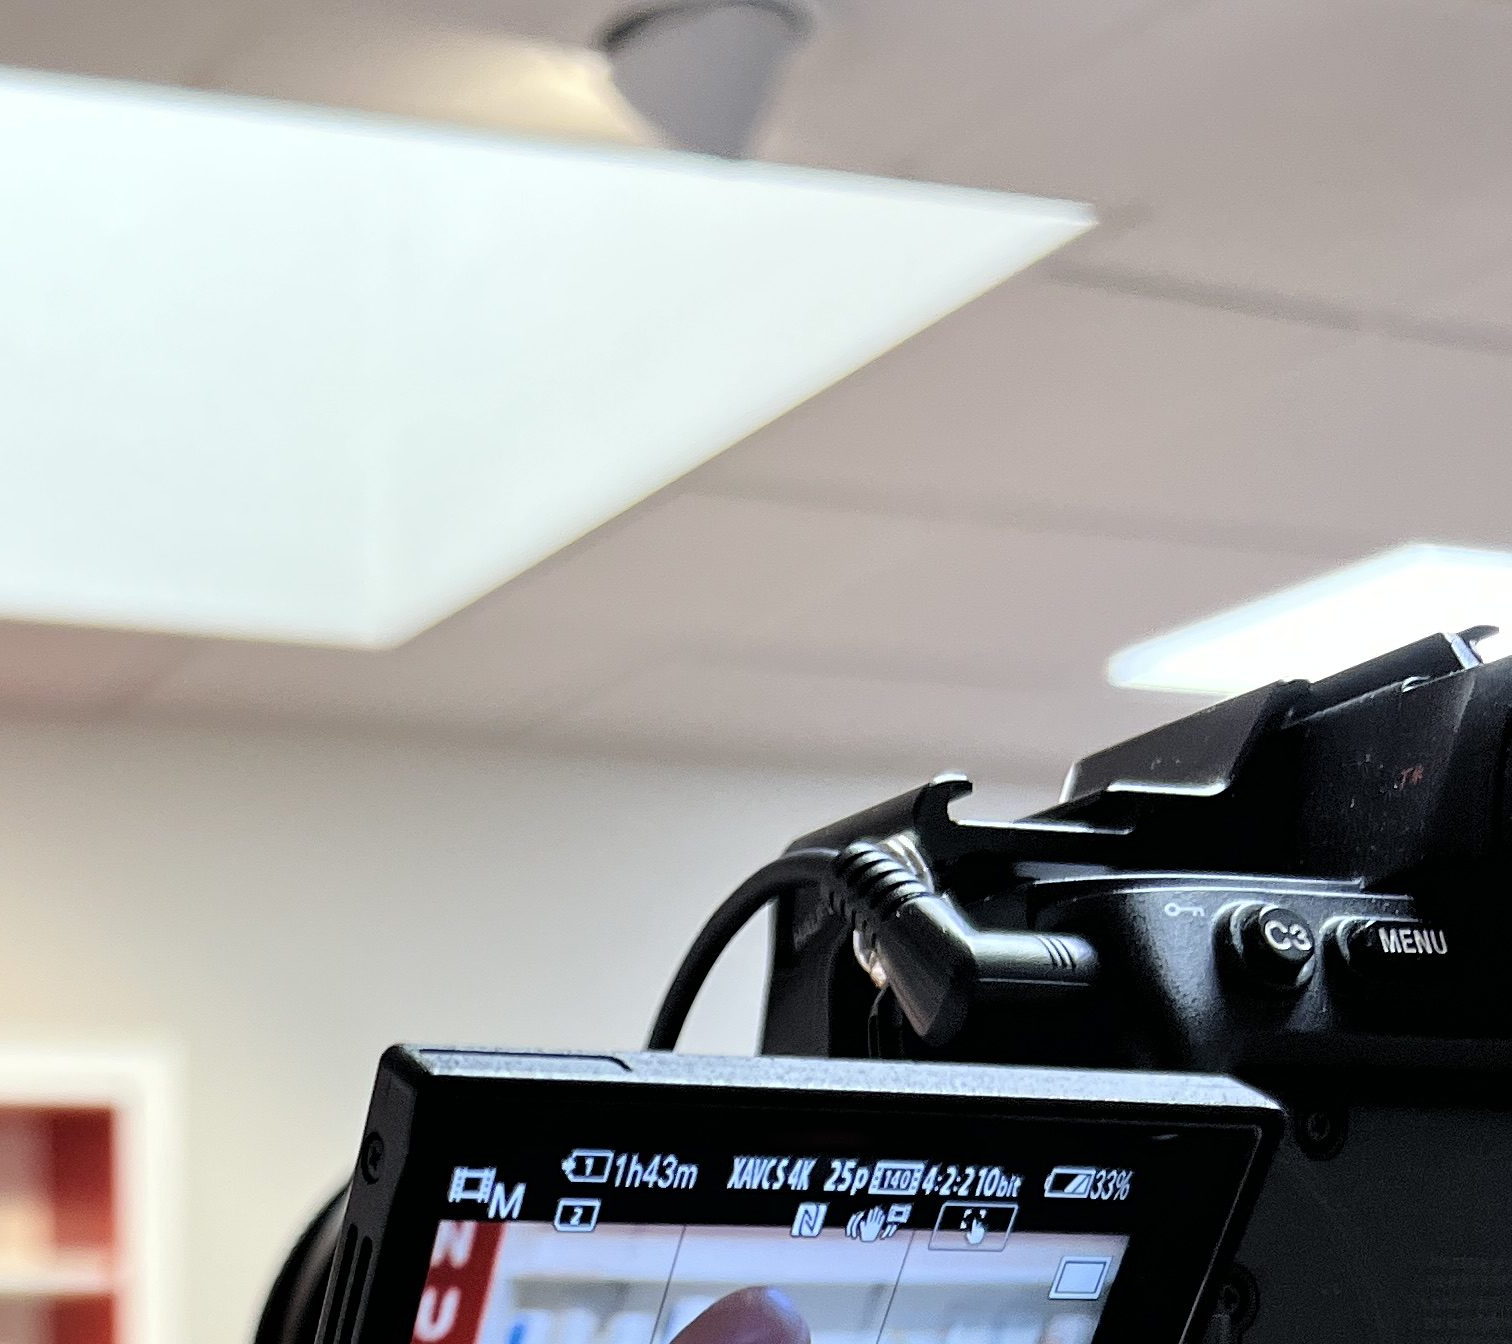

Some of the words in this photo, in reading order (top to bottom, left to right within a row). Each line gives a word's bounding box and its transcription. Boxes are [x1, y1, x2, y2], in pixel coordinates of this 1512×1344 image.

[1264, 920, 1313, 951] C3
[1378, 927, 1448, 955] MENU
[614, 1153, 698, 1189] 1h43m
[824, 1158, 868, 1196] 25p
[1089, 1168, 1133, 1200] 33%
[488, 1183, 526, 1219] M
